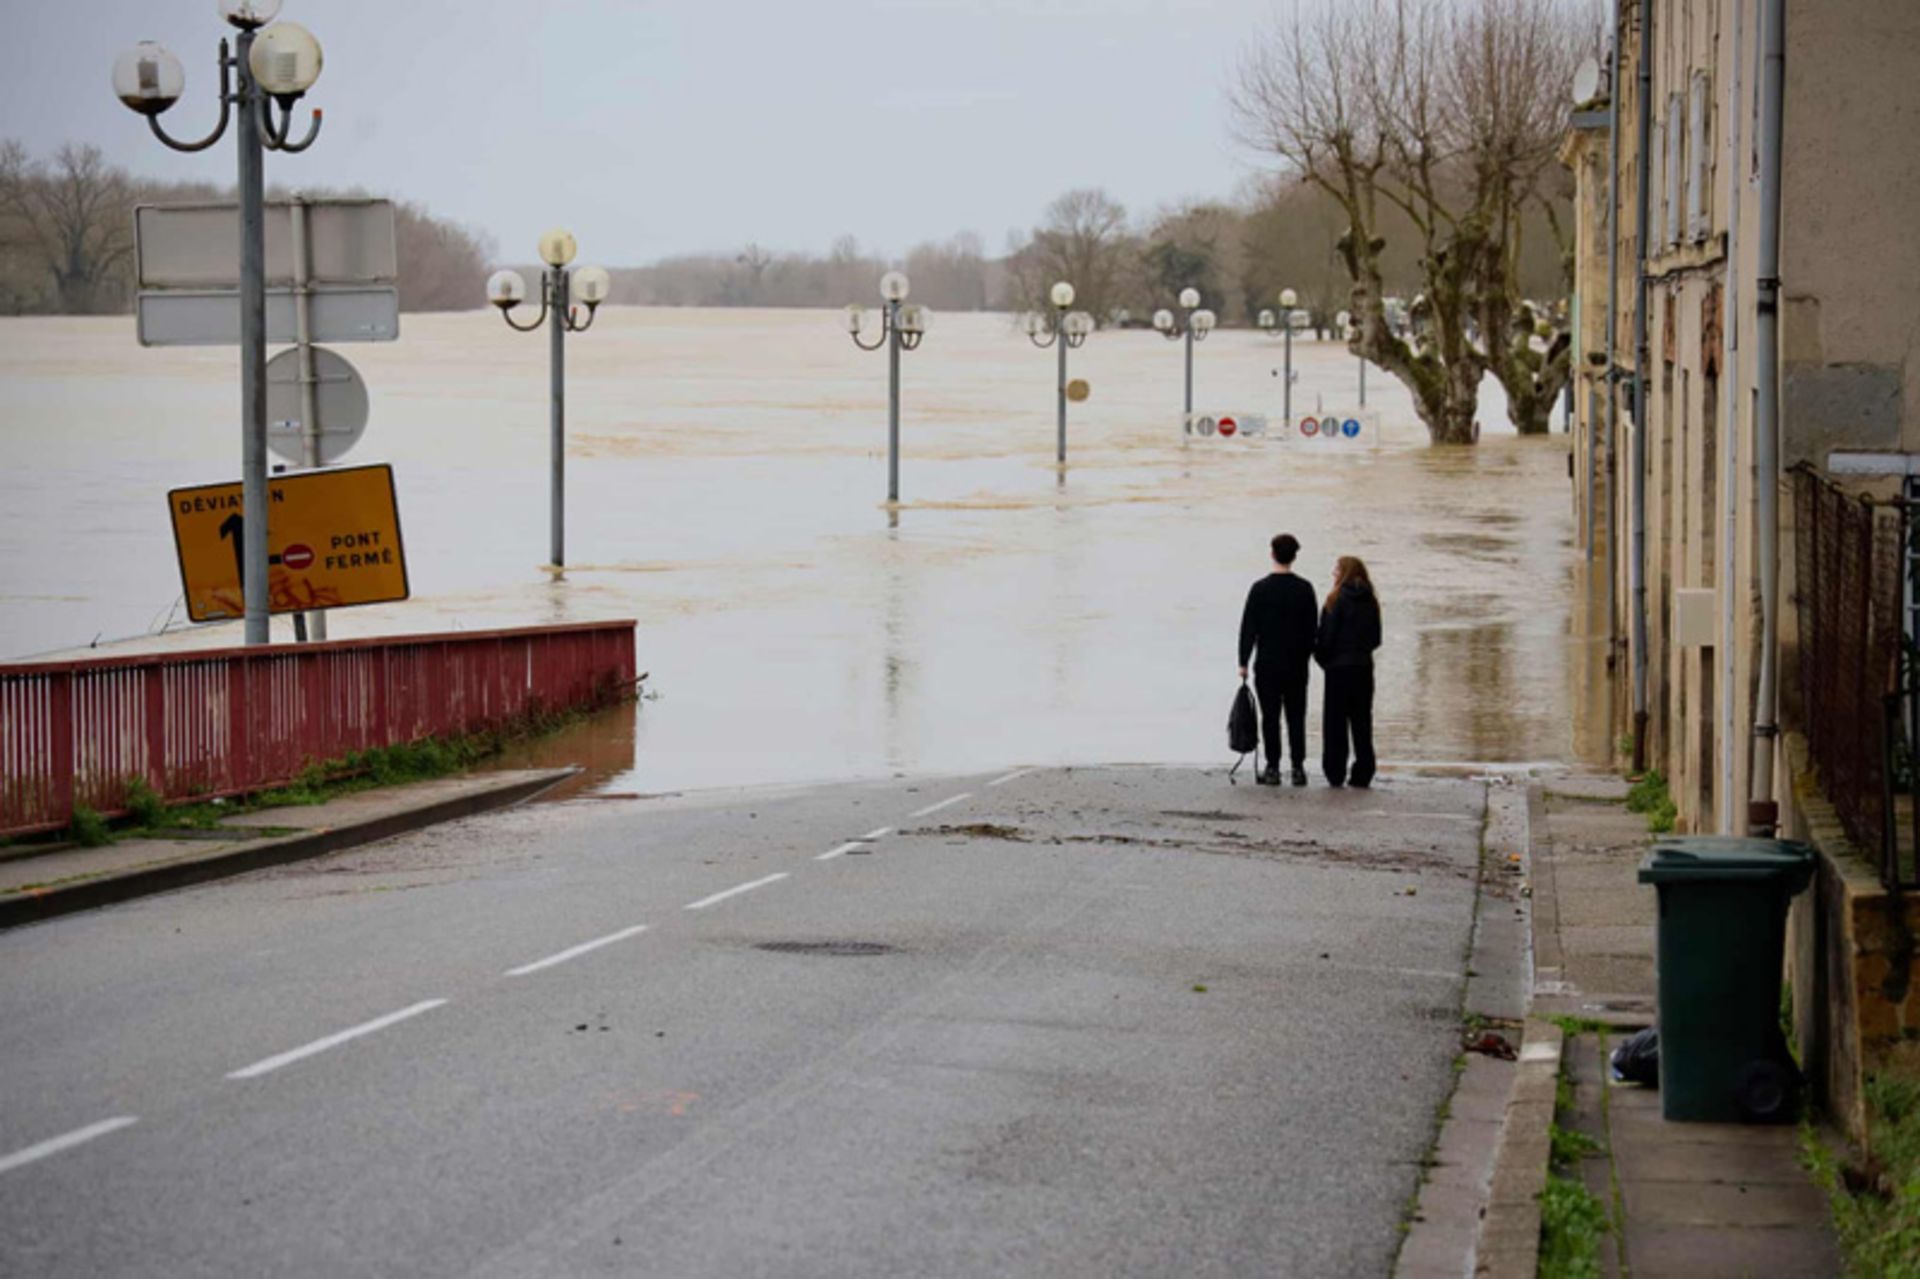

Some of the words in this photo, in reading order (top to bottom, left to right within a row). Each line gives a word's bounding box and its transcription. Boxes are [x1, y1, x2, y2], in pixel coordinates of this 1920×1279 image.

[181, 489, 283, 514] DÉVIAN
[332, 532, 379, 549] PONT
[326, 547, 392, 570] FERMÉ
